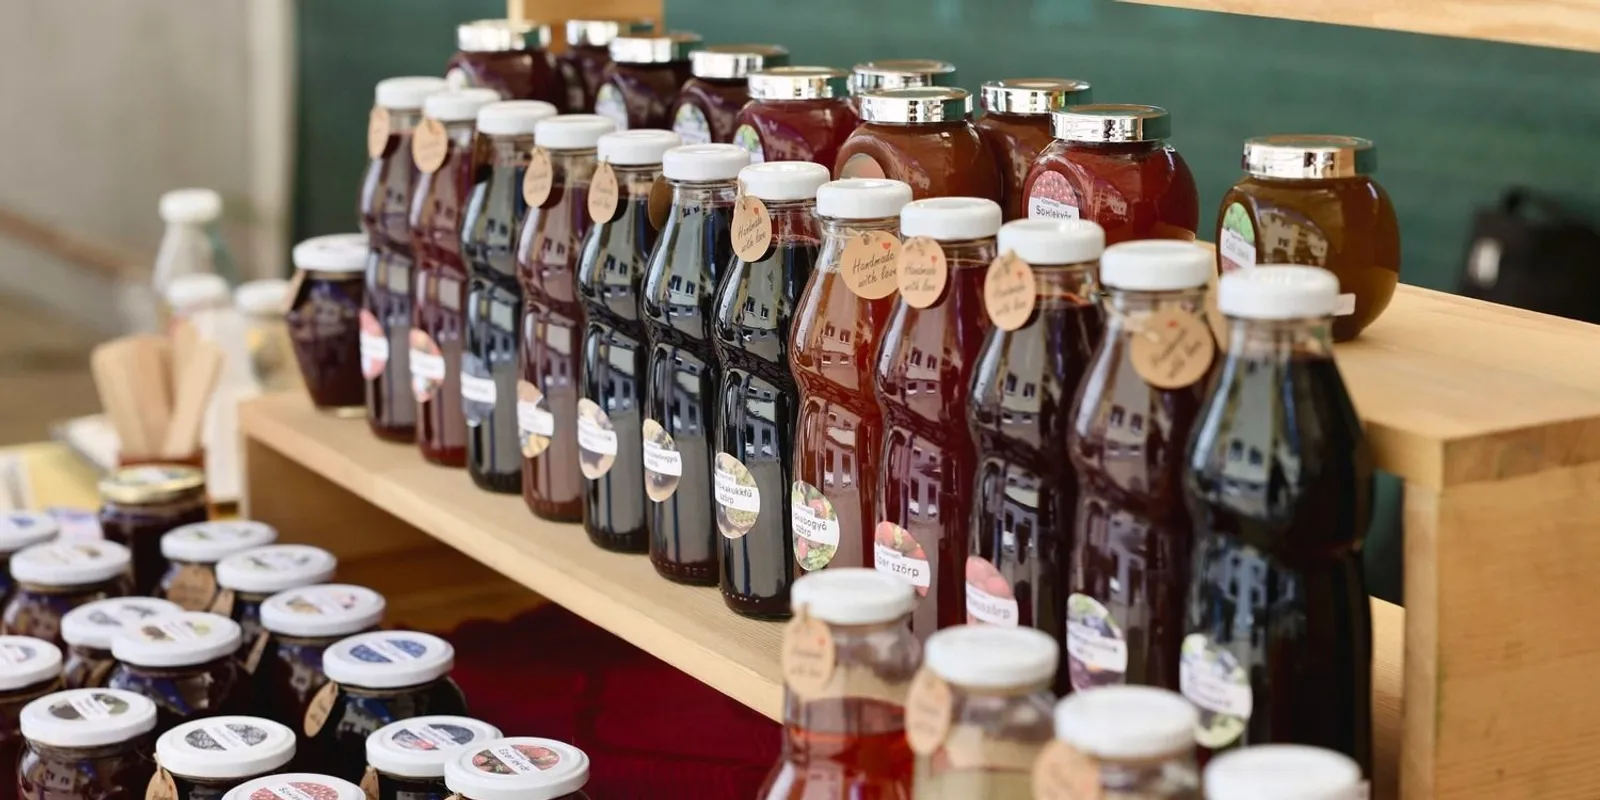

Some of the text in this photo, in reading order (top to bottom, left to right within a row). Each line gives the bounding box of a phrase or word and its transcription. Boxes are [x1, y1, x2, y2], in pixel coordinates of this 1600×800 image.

[852, 249, 895, 275] Handmade
[858, 270, 877, 288] with
[891, 563, 920, 579] szörp
